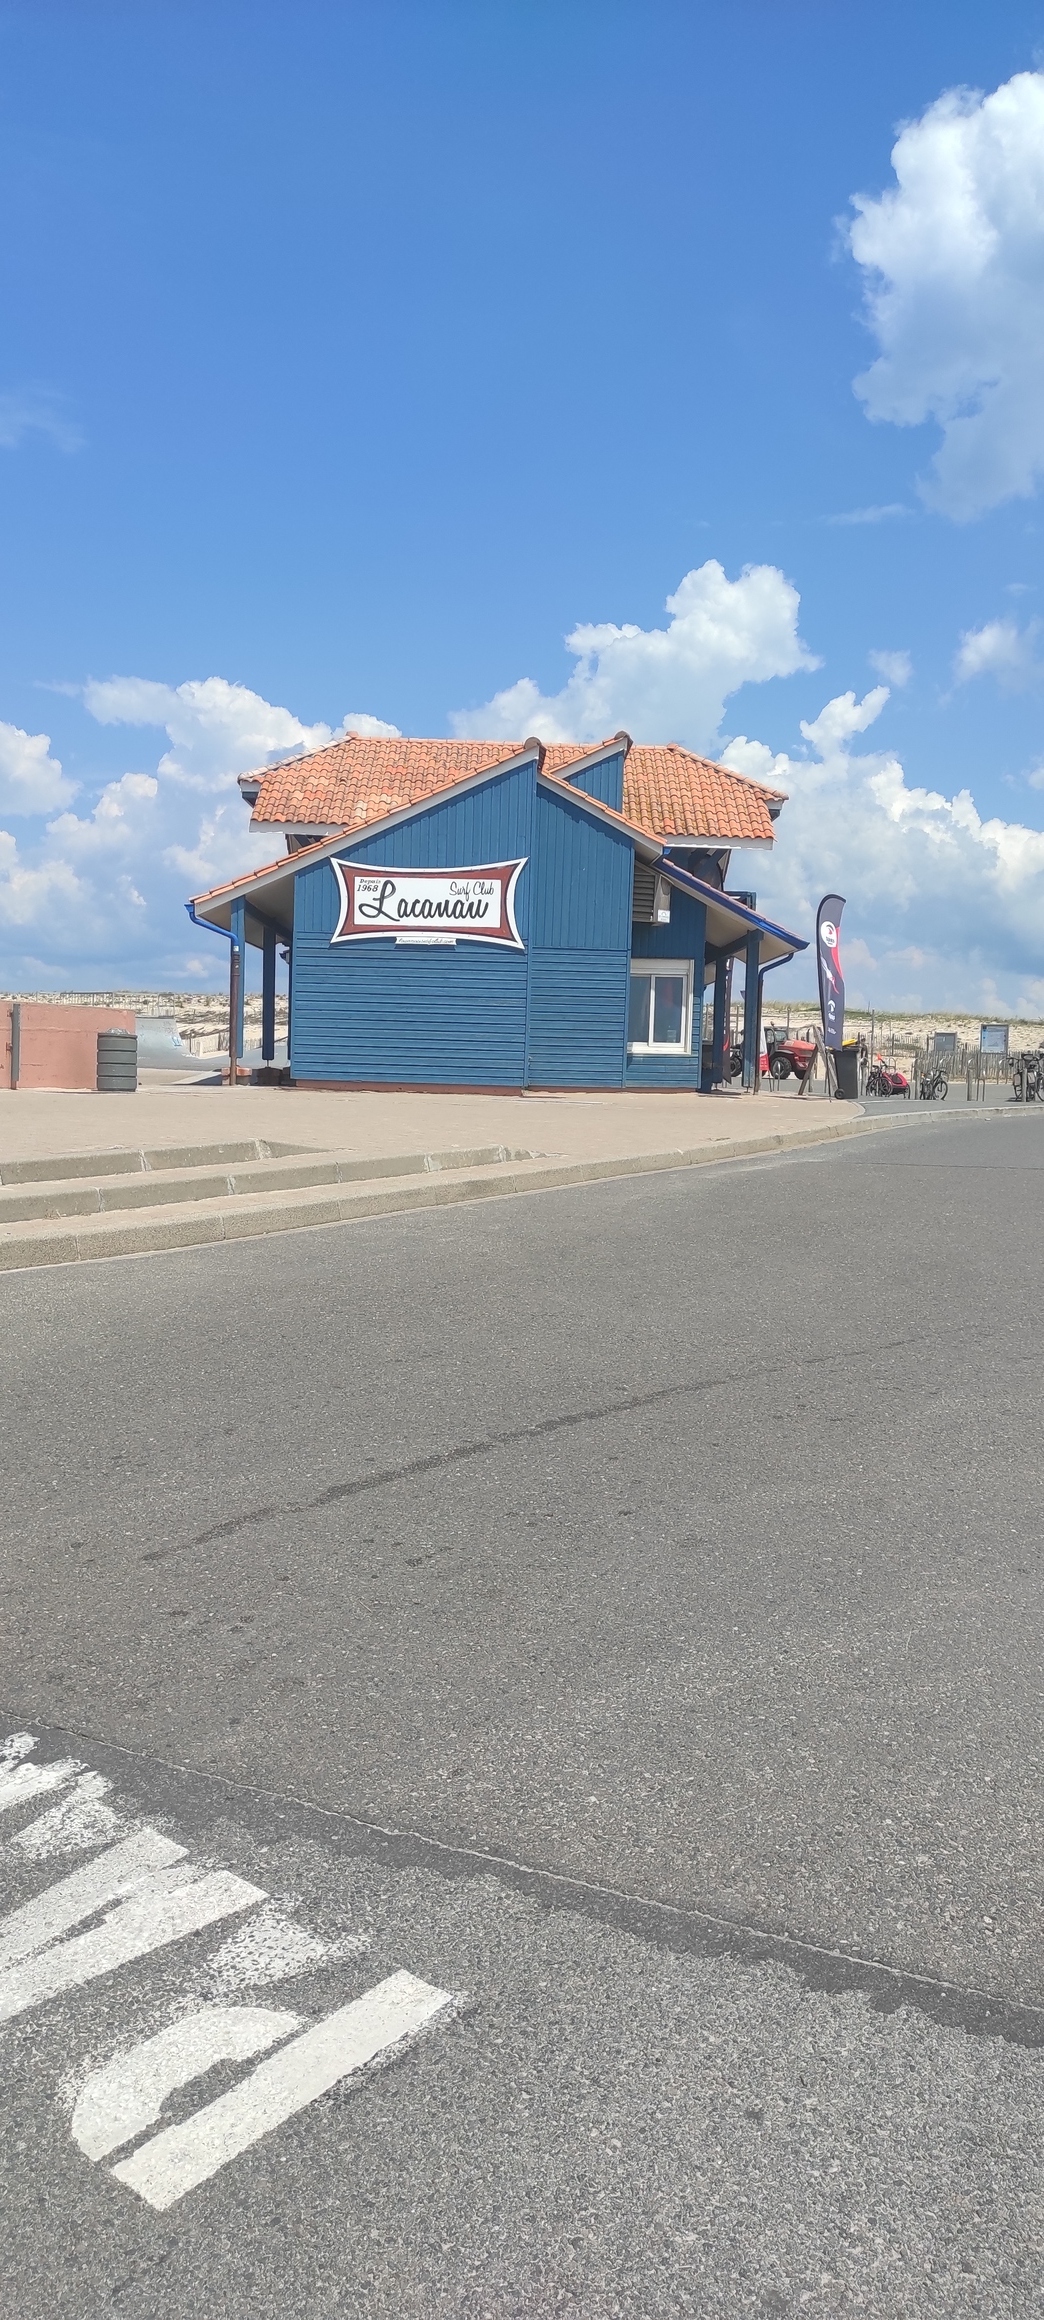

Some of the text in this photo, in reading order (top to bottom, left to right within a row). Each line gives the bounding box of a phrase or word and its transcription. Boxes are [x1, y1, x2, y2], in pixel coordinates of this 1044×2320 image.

[357, 884, 379, 892] 1968
[449, 881, 495, 901] Surf Club
[358, 879, 489, 922] Lacanau
